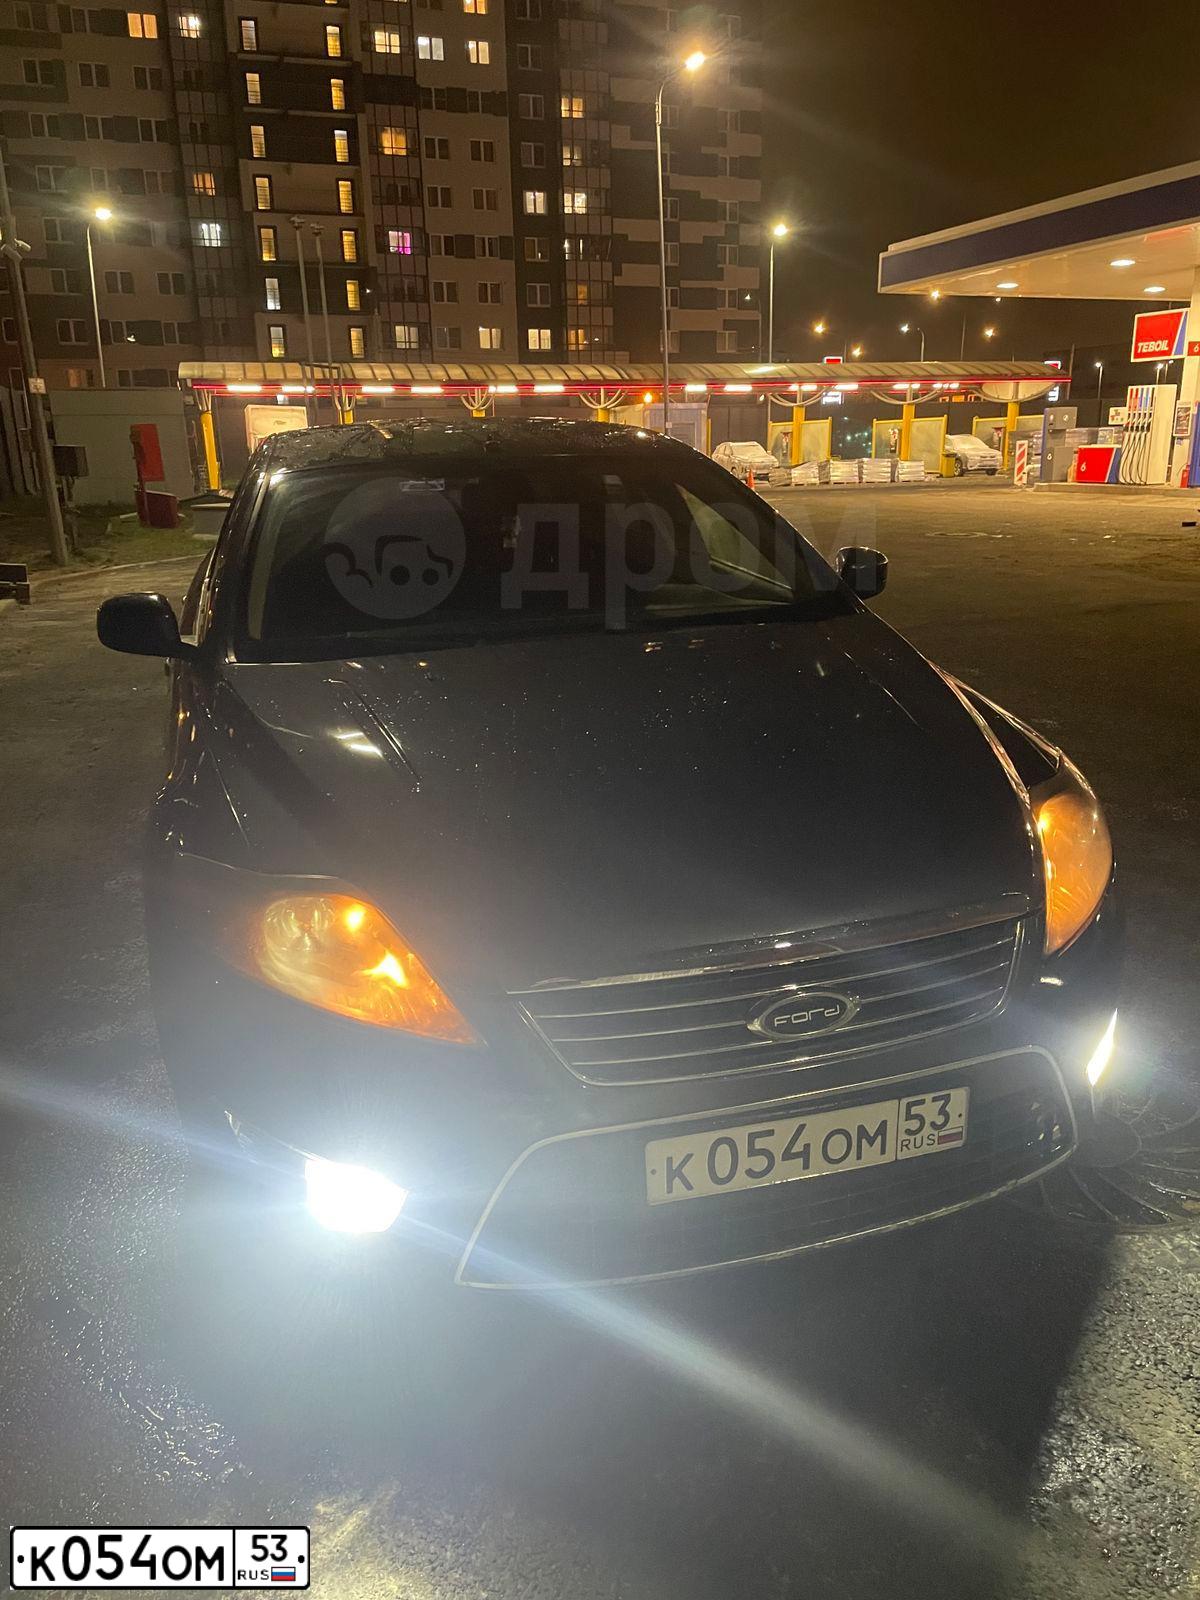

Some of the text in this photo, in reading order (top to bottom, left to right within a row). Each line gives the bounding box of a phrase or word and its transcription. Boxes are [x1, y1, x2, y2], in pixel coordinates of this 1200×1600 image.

[1137, 340, 1169, 353] TEBOIL
[1193, 343, 1200, 352] 6
[1080, 461, 1087, 472] 6
[904, 1093, 951, 1136] 53
[901, 1133, 936, 1152] RUS
